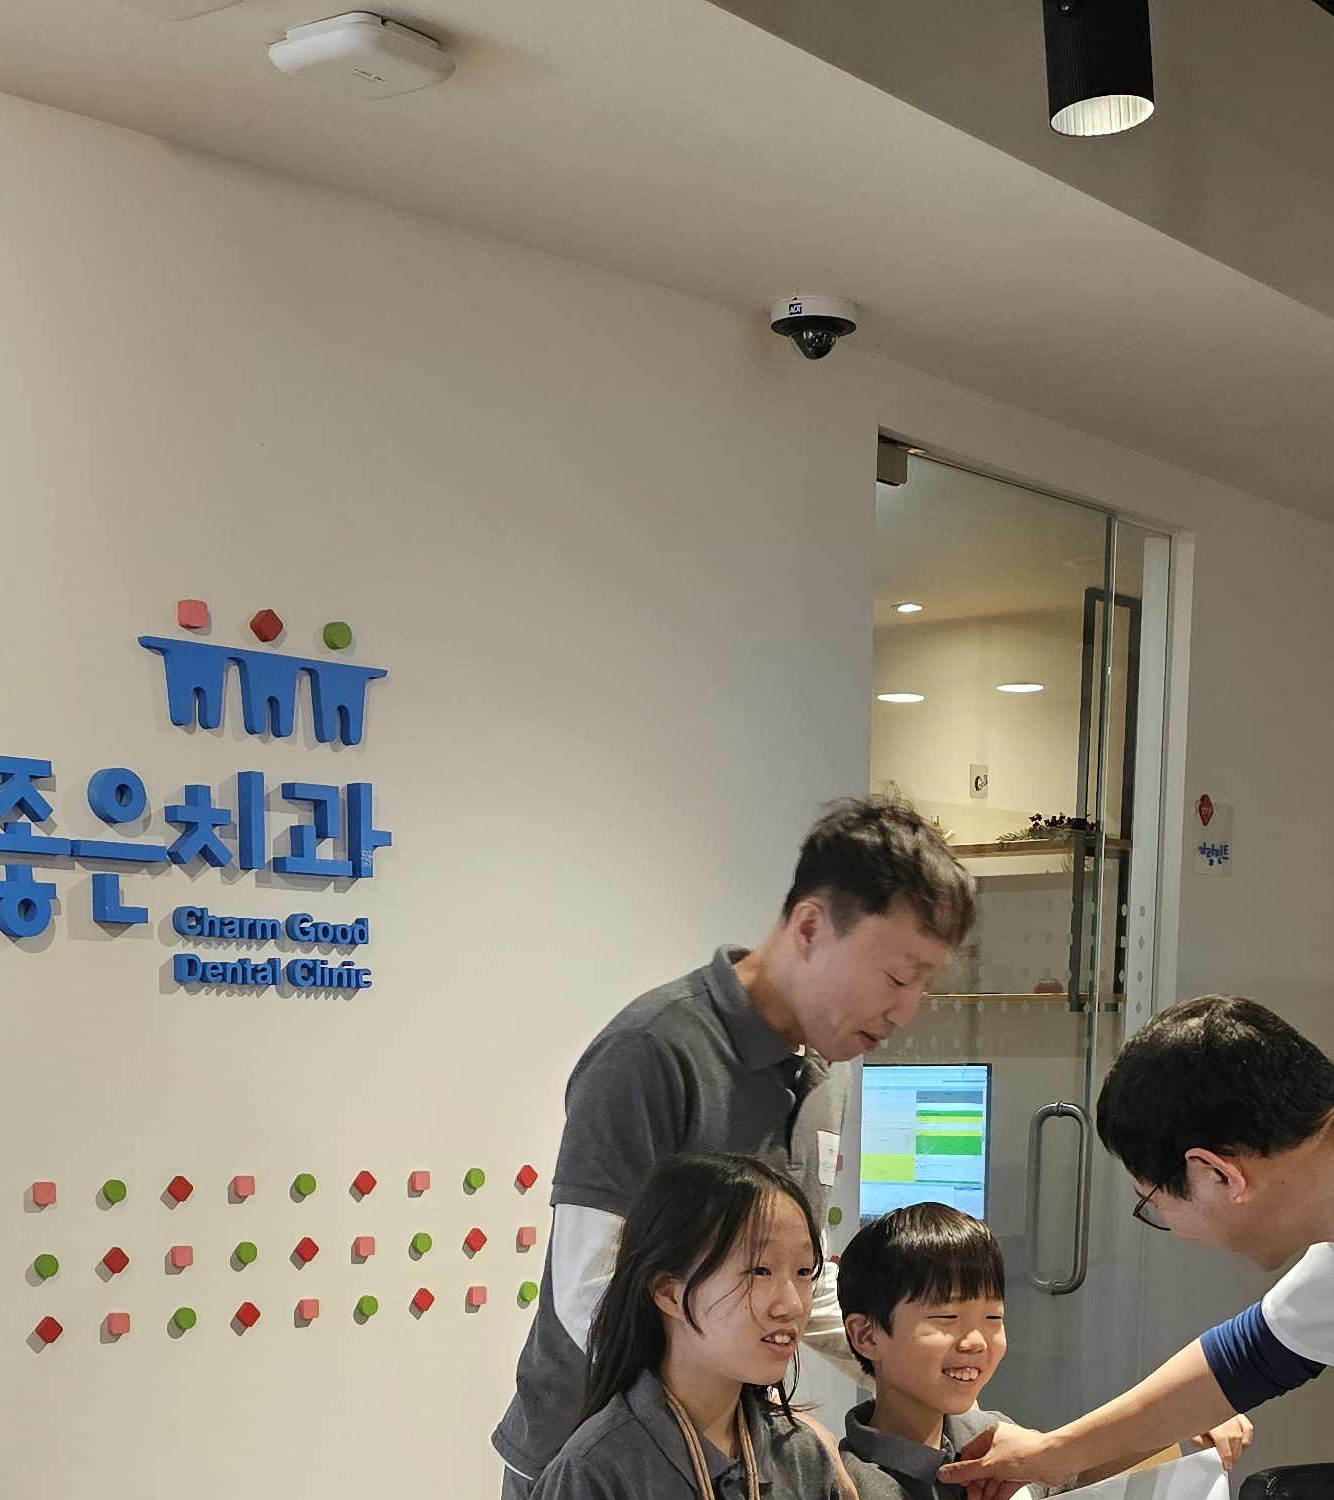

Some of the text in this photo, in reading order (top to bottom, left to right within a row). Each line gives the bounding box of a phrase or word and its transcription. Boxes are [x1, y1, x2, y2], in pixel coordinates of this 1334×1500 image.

[789, 303, 802, 315] ADT
[172, 906, 369, 945] Charm Good
[173, 953, 373, 989] Dental Clinic
